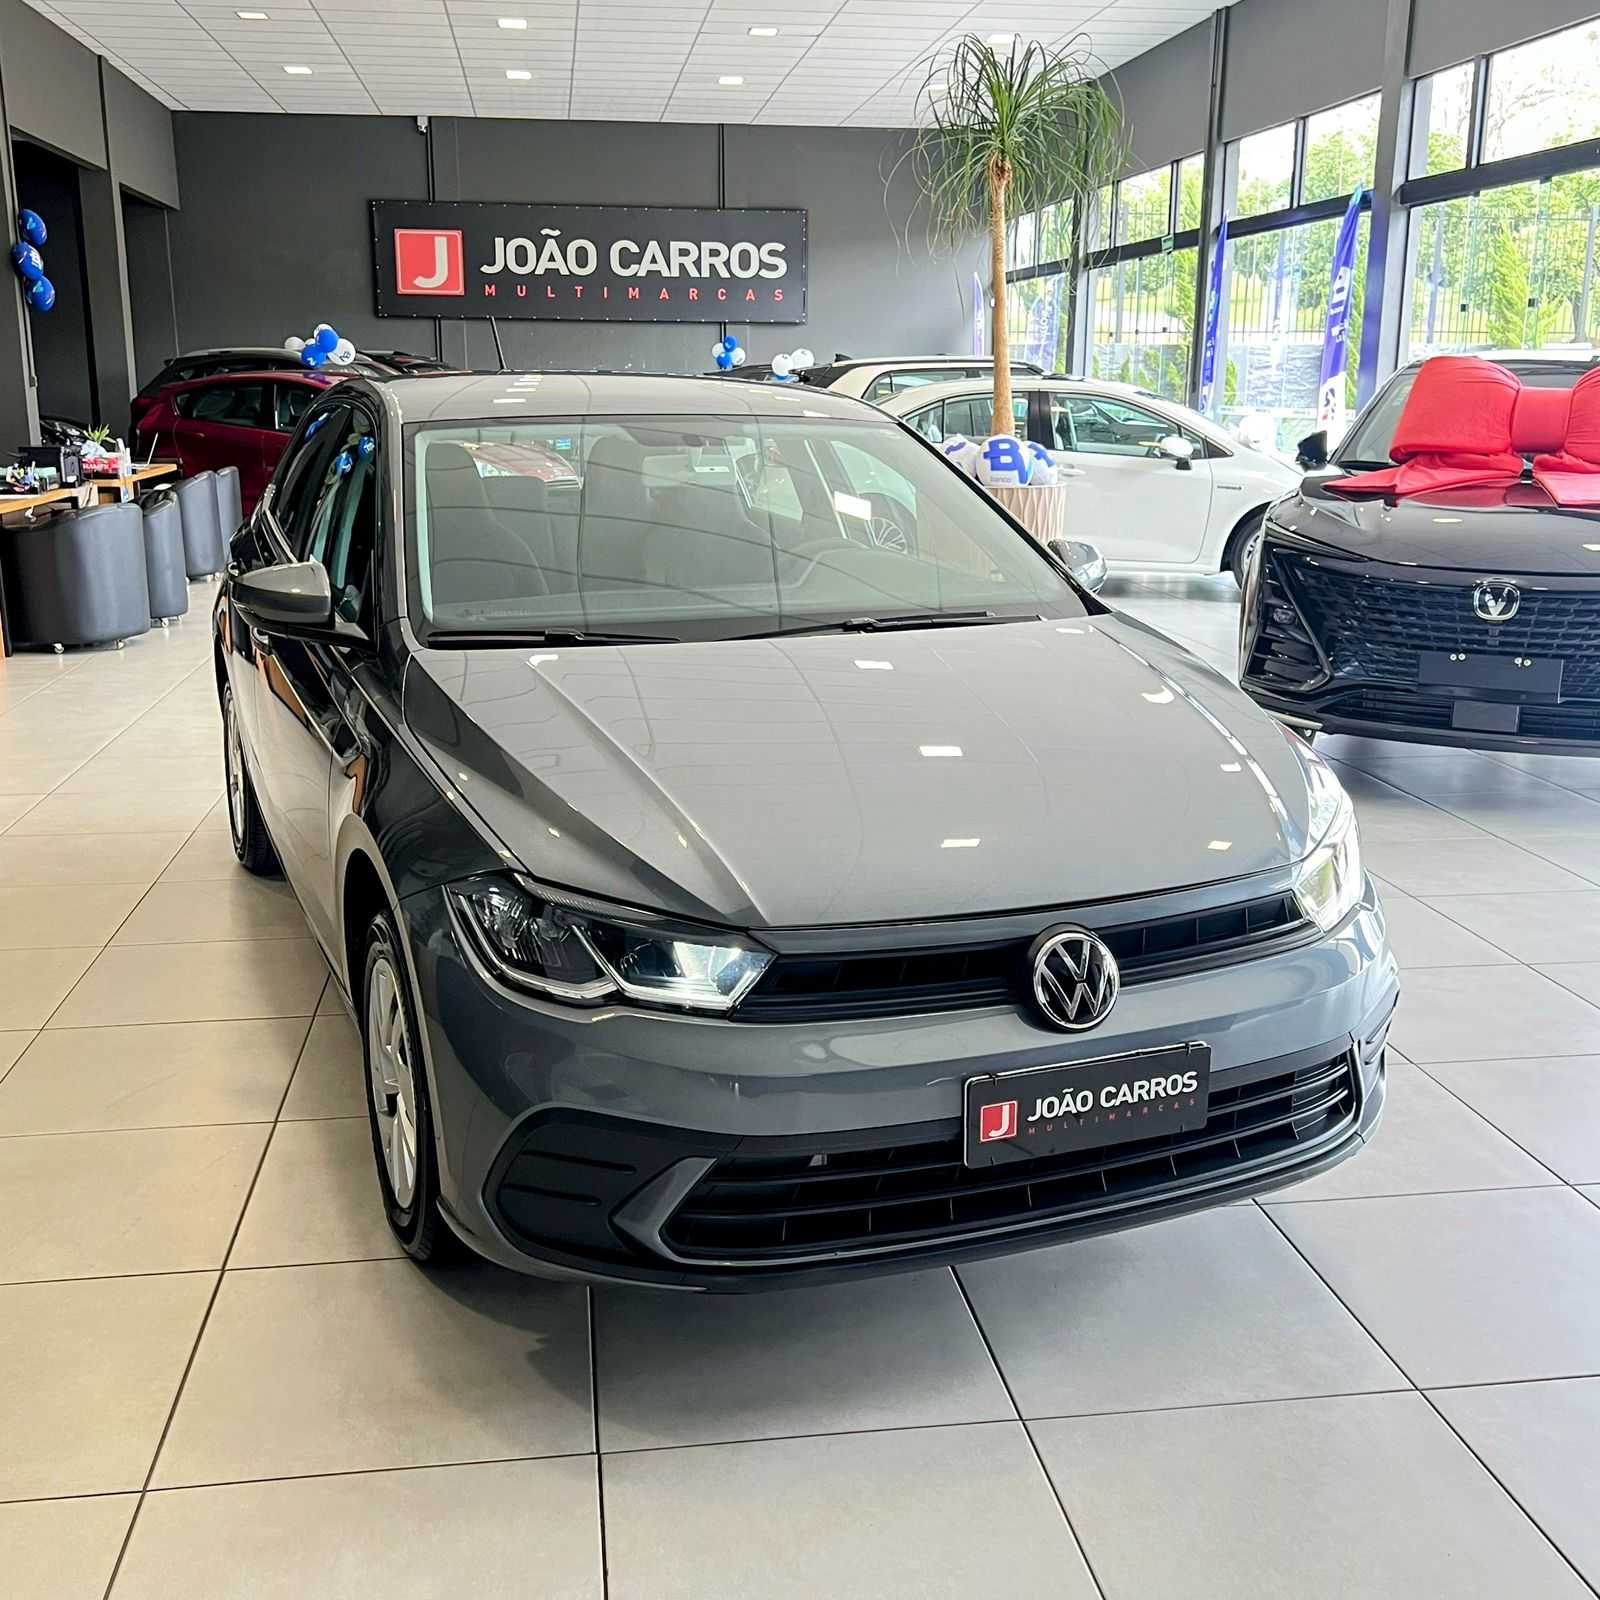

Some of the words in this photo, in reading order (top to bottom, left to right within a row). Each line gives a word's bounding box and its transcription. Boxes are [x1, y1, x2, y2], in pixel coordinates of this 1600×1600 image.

[413, 236, 449, 289] J
[480, 228, 598, 277] JOÃO
[609, 239, 788, 280] CARROS
[484, 283, 785, 302] MULTIMARCAS
[1026, 1087, 1094, 1122] JOÃO
[1099, 1071, 1198, 1108] CARROS
[1027, 1098, 1196, 1135] MULTIMARCAS
[988, 1103, 1010, 1138] J
